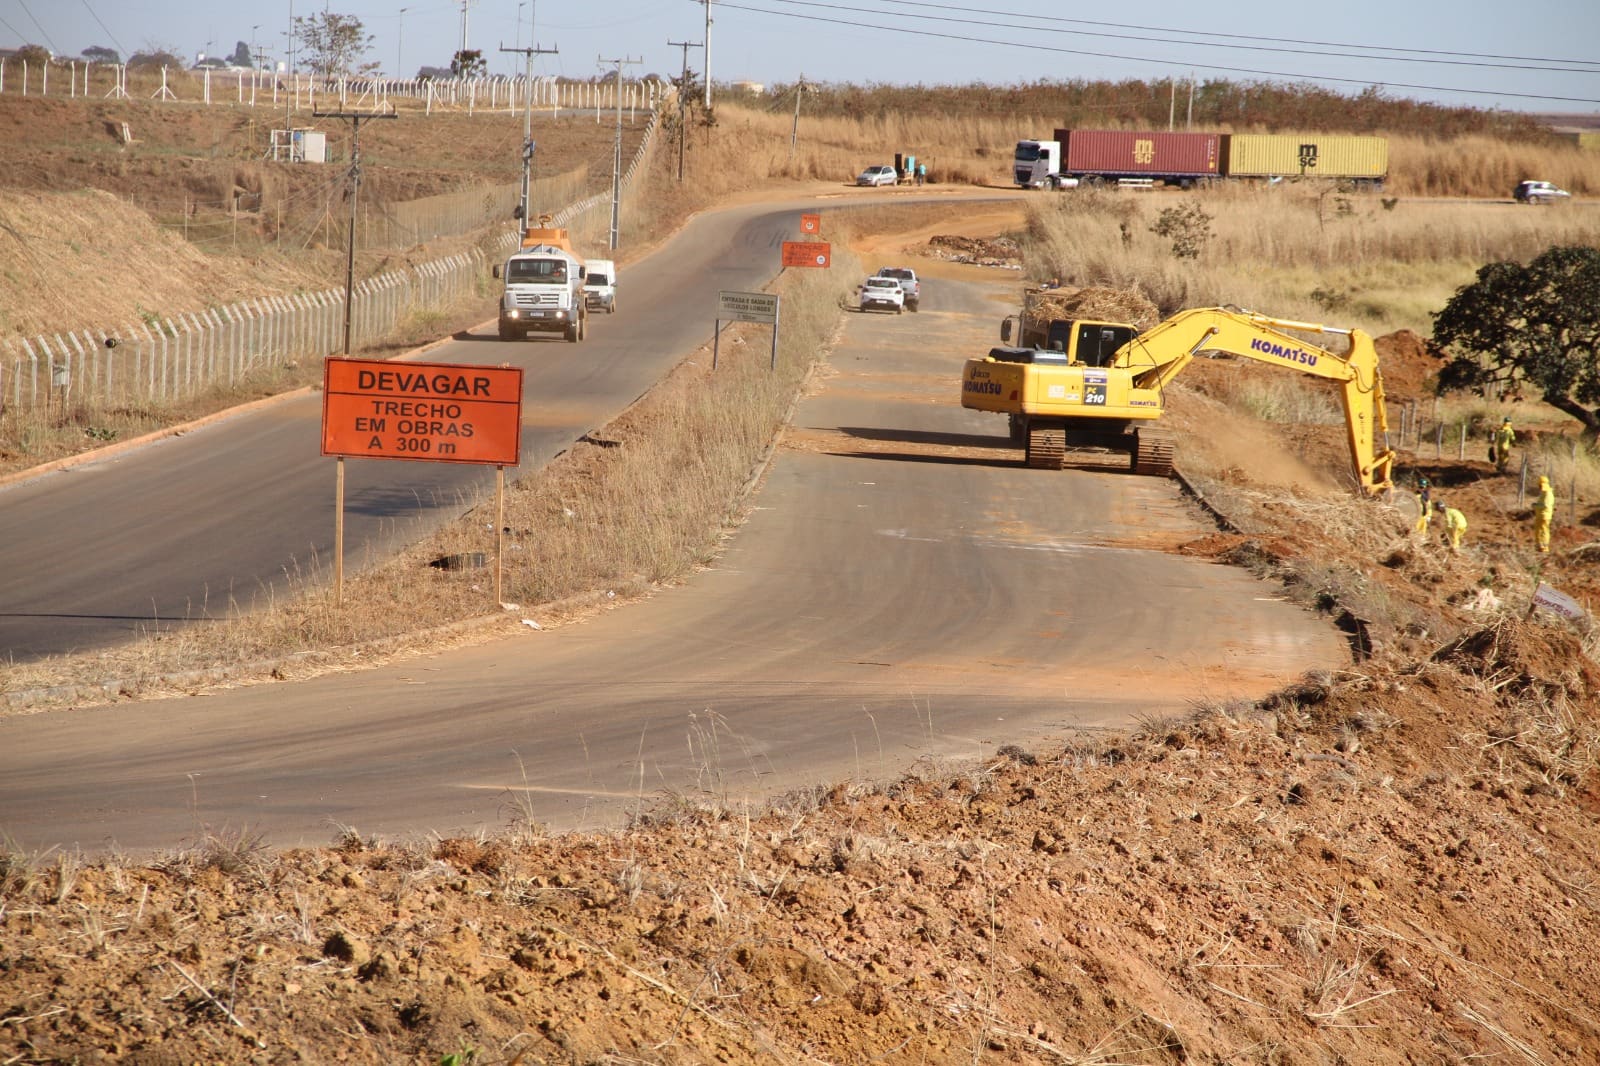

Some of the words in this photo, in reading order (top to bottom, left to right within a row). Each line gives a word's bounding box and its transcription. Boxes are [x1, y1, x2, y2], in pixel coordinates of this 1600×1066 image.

[1251, 338, 1318, 366] KOMATSU
[358, 370, 491, 397] DEVAGAR
[964, 380, 1002, 395] KOMATSU
[1085, 394, 1104, 403] 210
[372, 401, 462, 419] TRECHO
[355, 417, 386, 432] EM
[397, 420, 474, 437] OBRAS
[368, 436, 383, 450] A
[396, 438, 431, 453] 300
[438, 442, 456, 454] m
